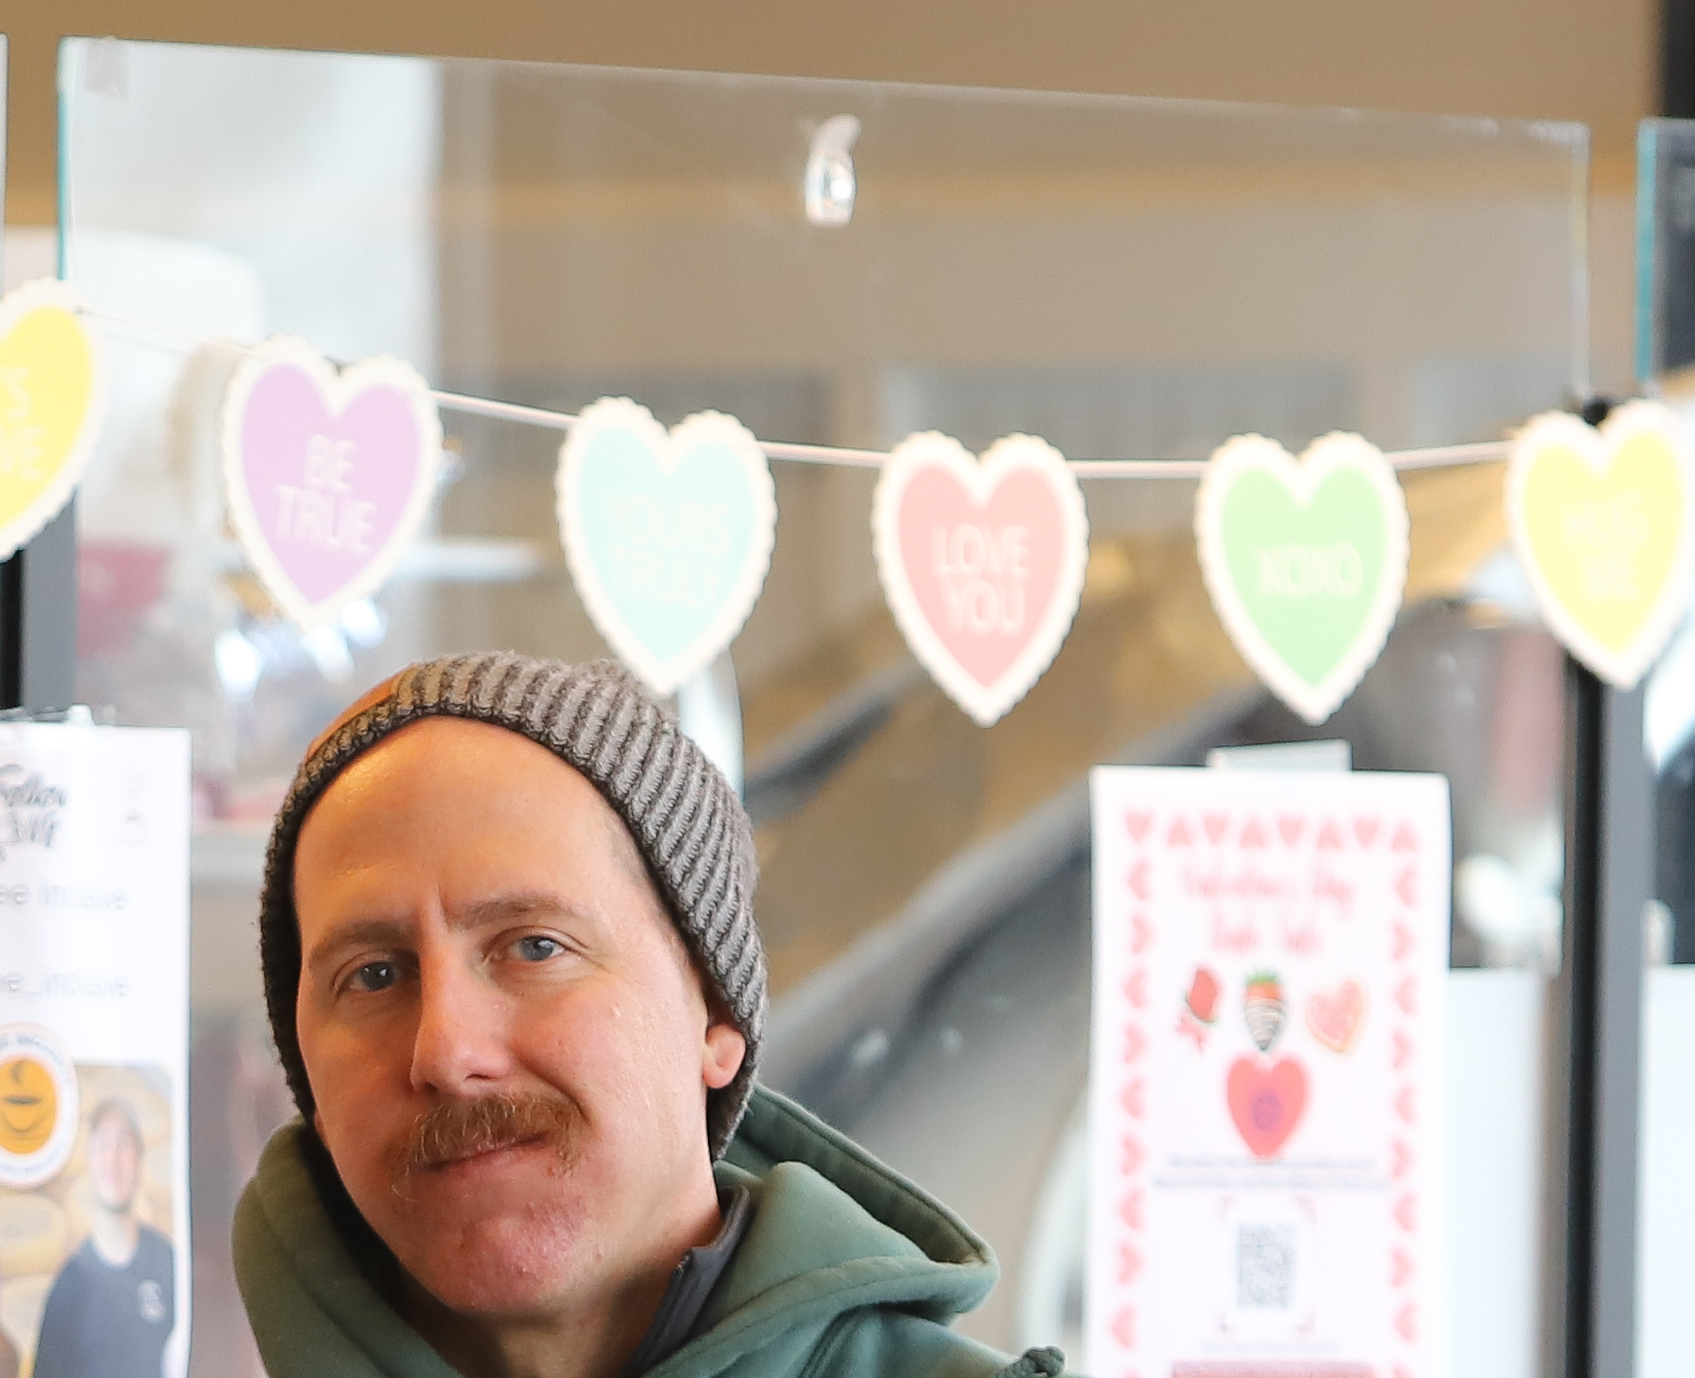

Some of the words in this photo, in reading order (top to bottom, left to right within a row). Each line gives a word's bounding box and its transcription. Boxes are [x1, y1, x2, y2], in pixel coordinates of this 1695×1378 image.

[303, 433, 359, 495] BE
[273, 484, 379, 558] TRUE
[930, 522, 1033, 580] LOVE
[936, 575, 1026, 638] YOU
